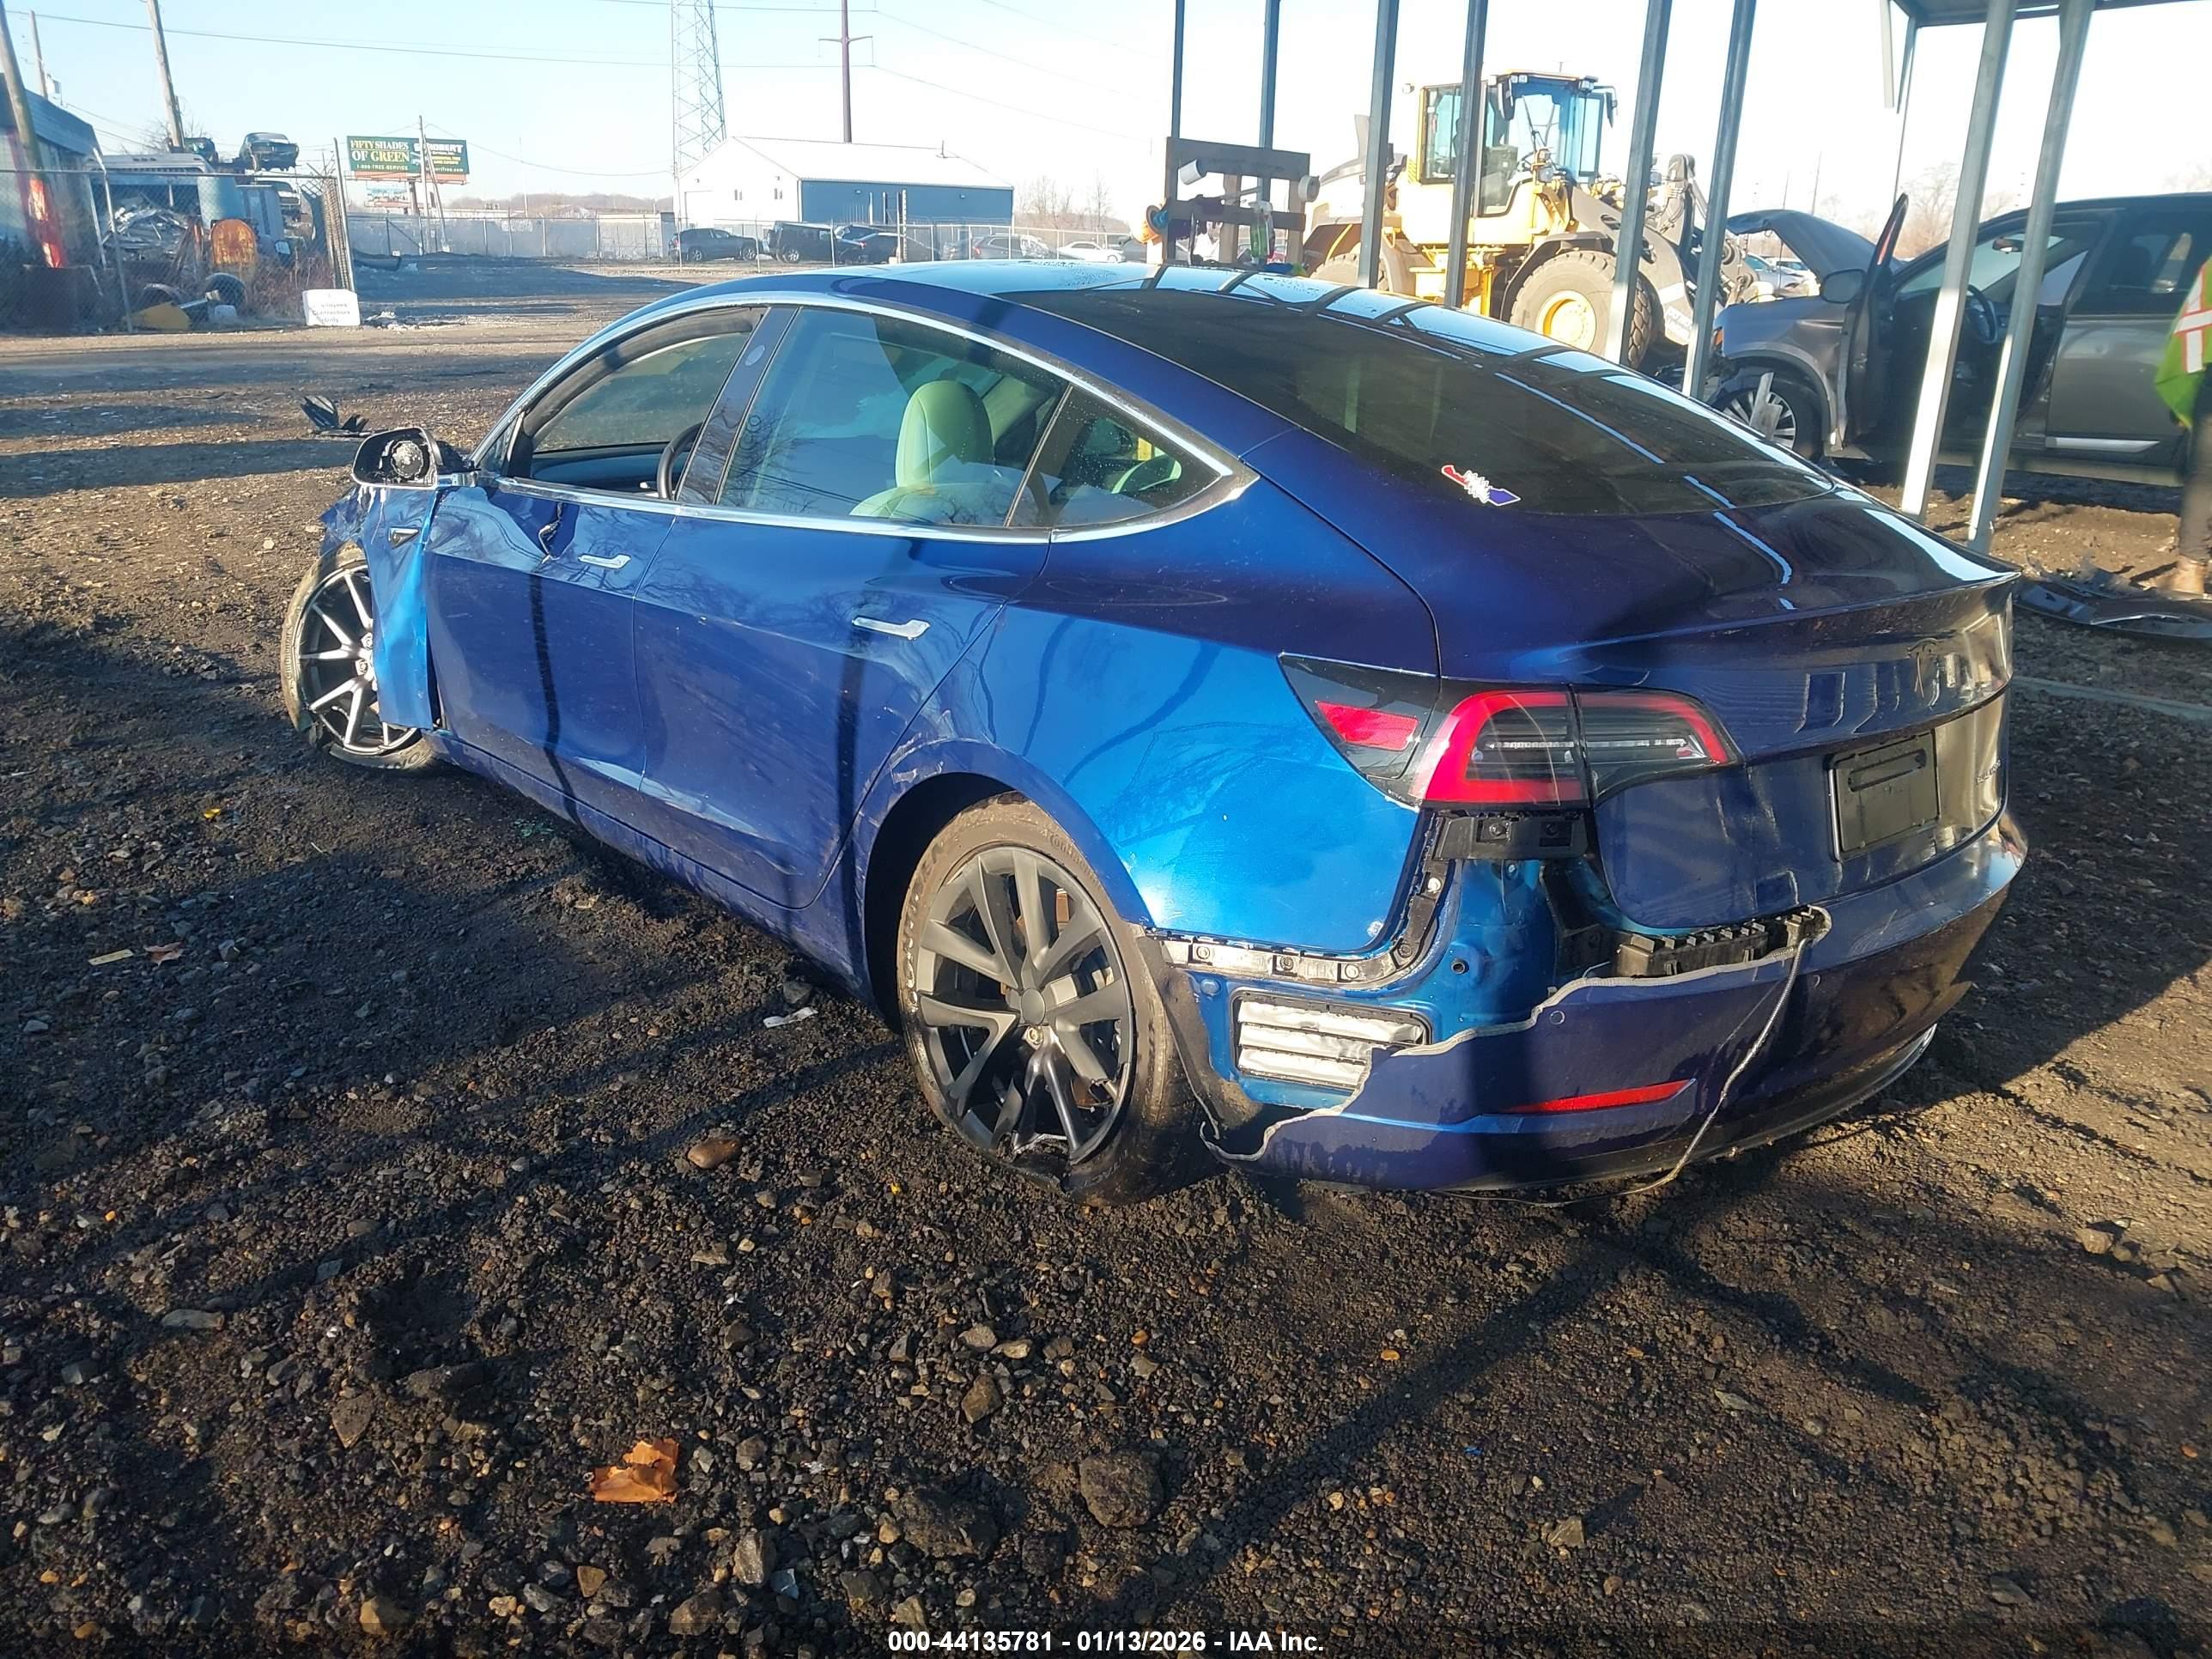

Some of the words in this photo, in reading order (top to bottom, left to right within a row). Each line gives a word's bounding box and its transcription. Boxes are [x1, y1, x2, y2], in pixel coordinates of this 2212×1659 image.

[350, 140, 374, 149] FIFTY
[374, 141, 410, 150] SHADES
[351, 150, 368, 161] OF
[370, 150, 410, 162] GREEN
